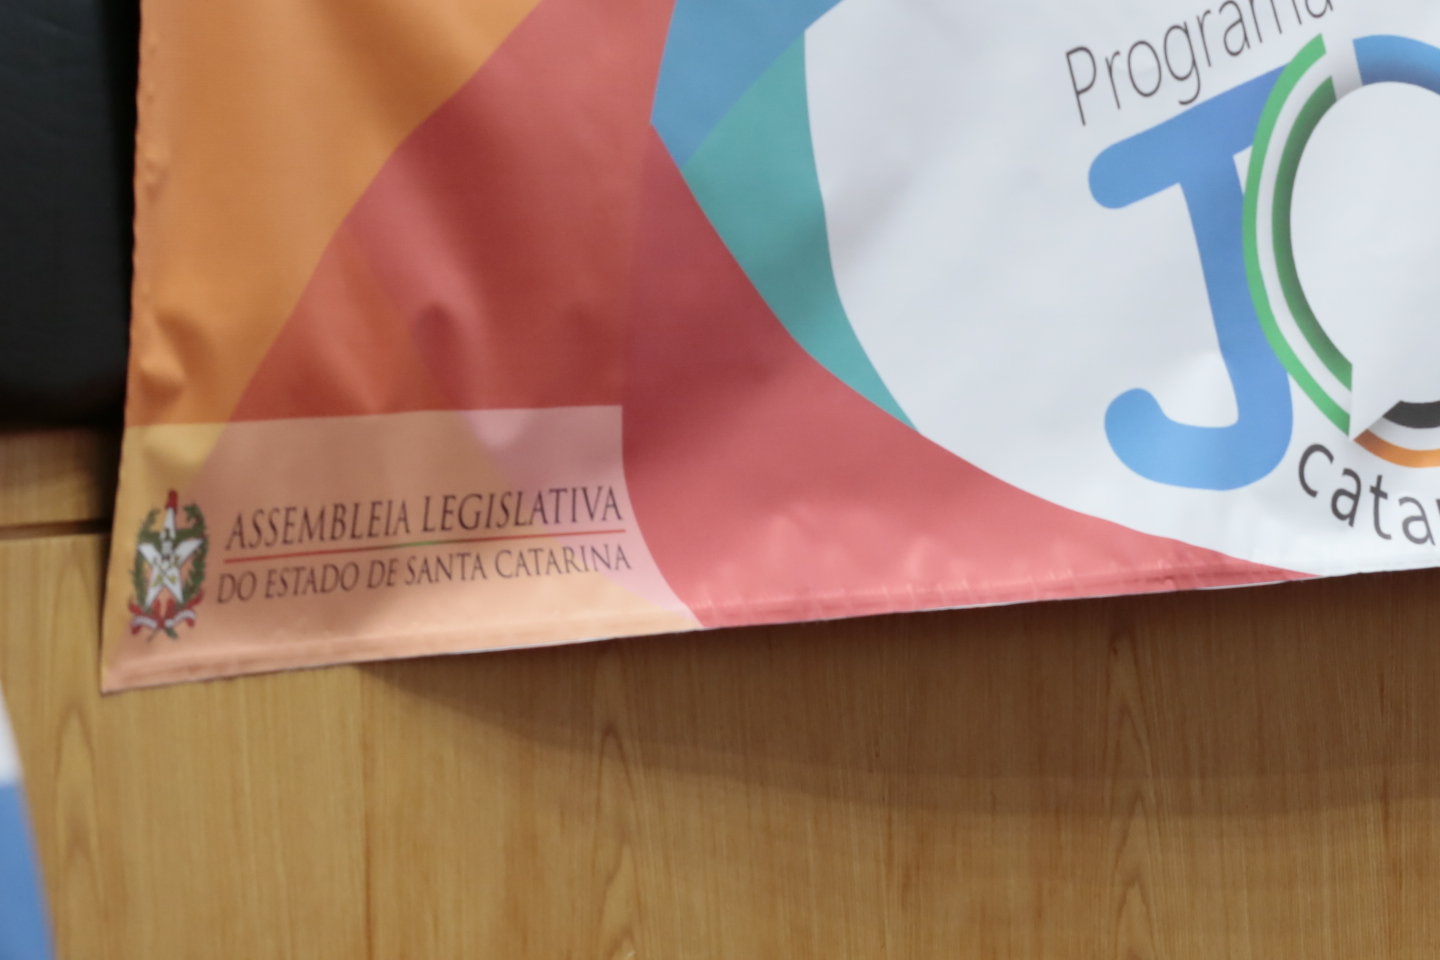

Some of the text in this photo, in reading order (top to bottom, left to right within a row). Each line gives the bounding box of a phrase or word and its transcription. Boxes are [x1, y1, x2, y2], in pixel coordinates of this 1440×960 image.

[225, 485, 624, 550] ASSEMBLEIA LEGISLATIVA
[216, 543, 633, 604] DO ESTADO DE SANTA CATARINA
